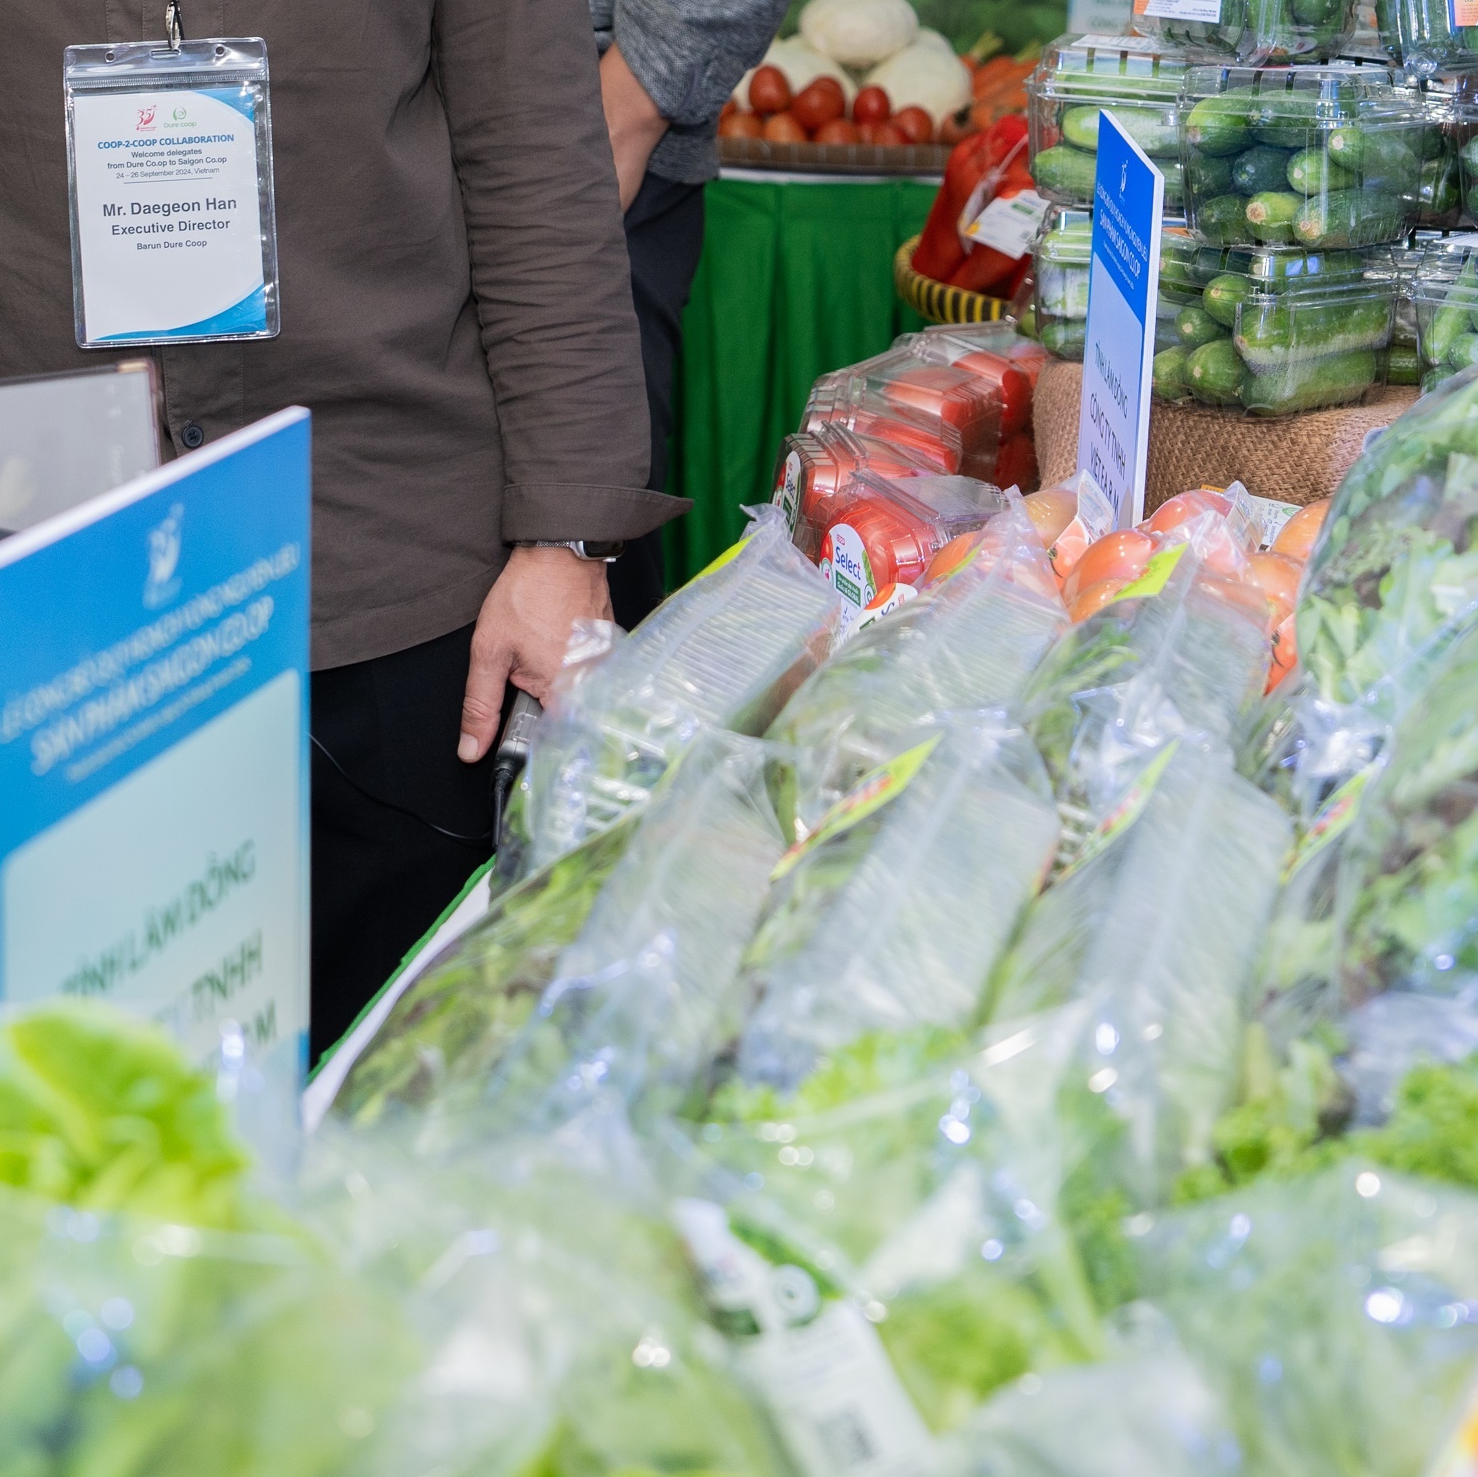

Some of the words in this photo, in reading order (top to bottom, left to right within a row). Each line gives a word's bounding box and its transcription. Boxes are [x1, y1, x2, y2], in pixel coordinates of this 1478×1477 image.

[97, 138, 157, 150] COOP-2-COOP
[159, 134, 235, 146] COLLABORATION
[131, 150, 165, 158] Welcome
[166, 148, 202, 158] delegates
[107, 162, 125, 170] from
[126, 160, 145, 168] Dure
[145, 160, 167, 169] Co.op
[178, 157, 204, 167] Saigon
[205, 156, 227, 165] Co.op
[140, 170, 174, 178] September
[175, 168, 193, 176] 2024,
[194, 166, 219, 174] Vietnam
[103, 203, 127, 216] Mr.
[131, 201, 201, 217] Daegeon
[206, 198, 237, 211] Han
[111, 222, 175, 236] Executive
[178, 220, 231, 232] Director
[137, 242, 161, 250] Barun
[163, 241, 183, 249] Dure
[185, 240, 207, 248] Coop
[1104, 419, 1111, 452] TY
[835, 546, 861, 580] Select
